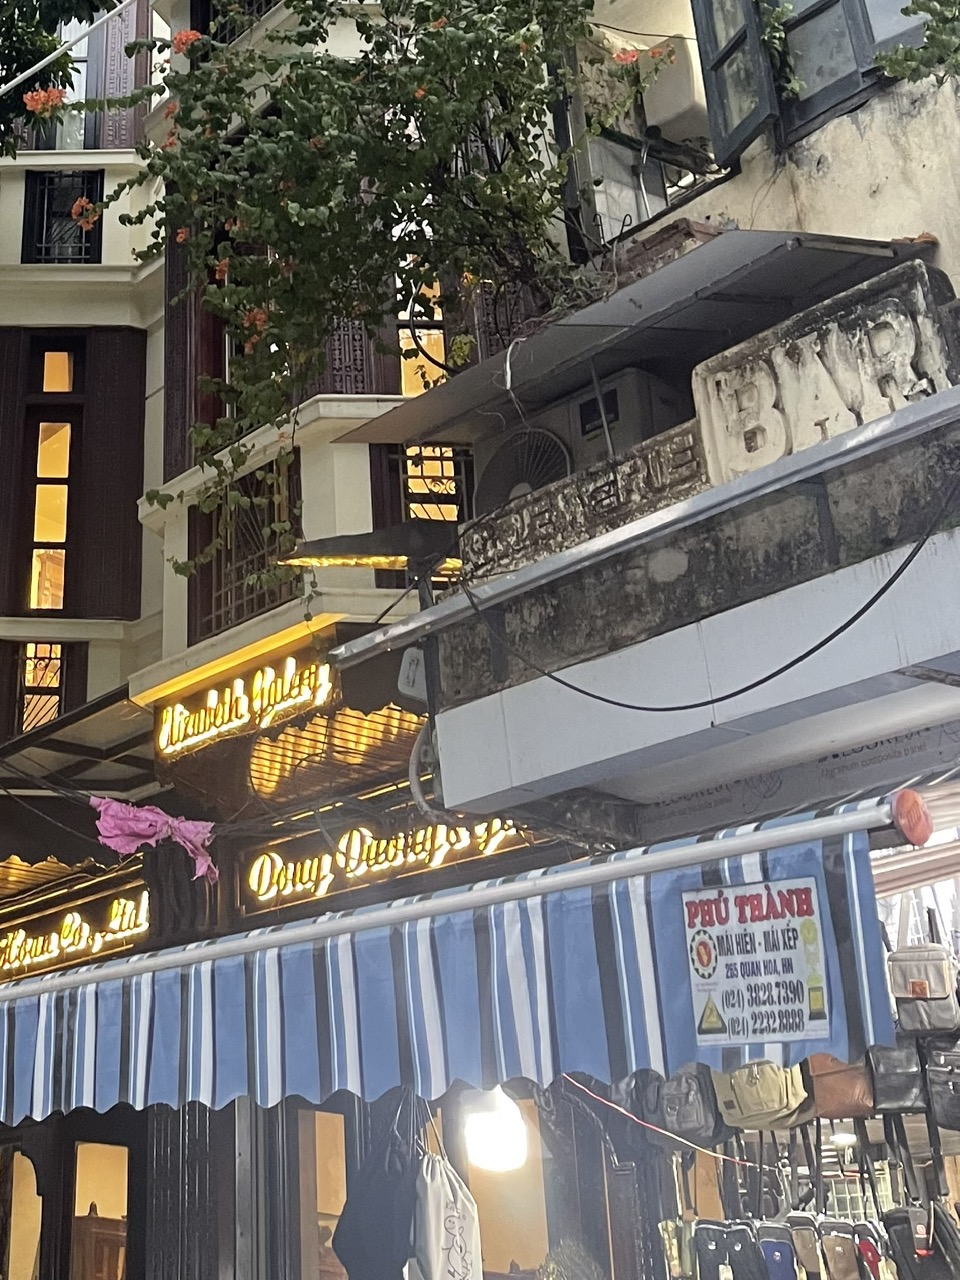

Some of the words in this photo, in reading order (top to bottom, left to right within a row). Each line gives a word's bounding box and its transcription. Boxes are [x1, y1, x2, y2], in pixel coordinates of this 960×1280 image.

[712, 297, 933, 480] BAR
[685, 890, 730, 929] PHÚ
[734, 884, 815, 924] THÀNH
[716, 930, 735, 957] MÁI
[735, 928, 757, 955] HIÊN
[763, 925, 780, 952] MÁI
[781, 920, 799, 950] XẾP
[781, 957, 794, 975] HN
